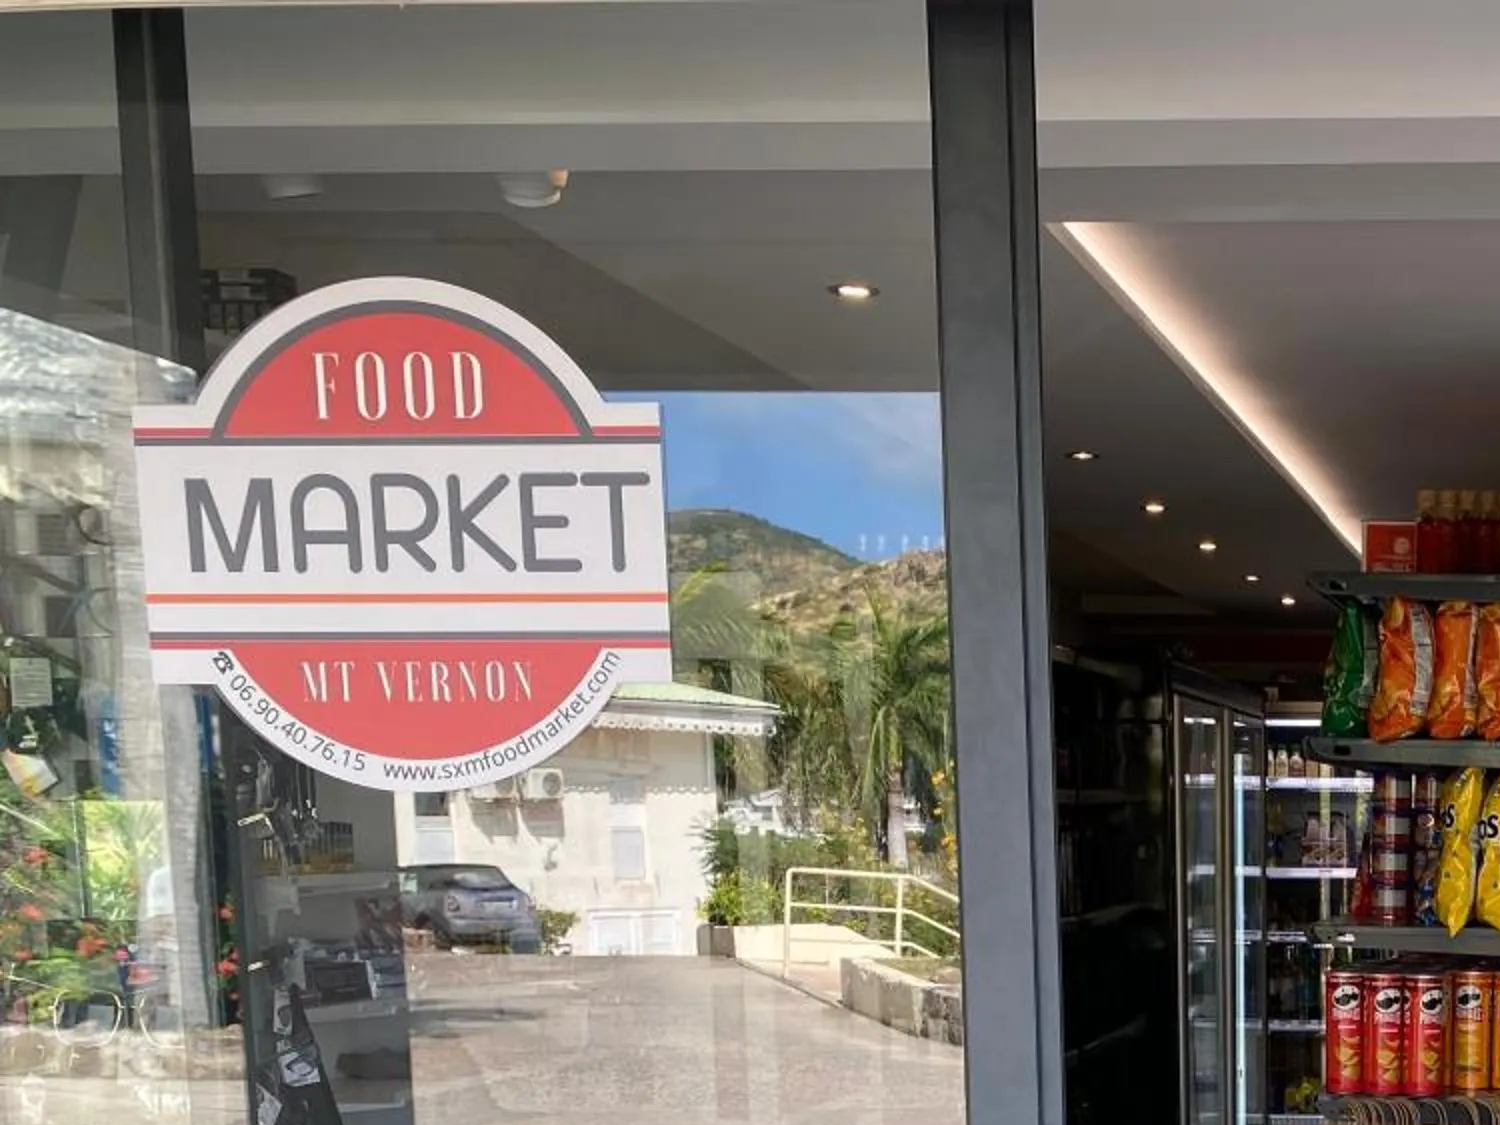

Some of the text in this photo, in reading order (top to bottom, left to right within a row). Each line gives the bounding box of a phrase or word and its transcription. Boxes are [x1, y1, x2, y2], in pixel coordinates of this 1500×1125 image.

[312, 351, 485, 421] FOOD
[184, 472, 650, 574] MARKET
[230, 650, 621, 782] 06.90.40.76.15 www.sxmfoodmarket.com
[302, 660, 534, 703] MT VERNON
